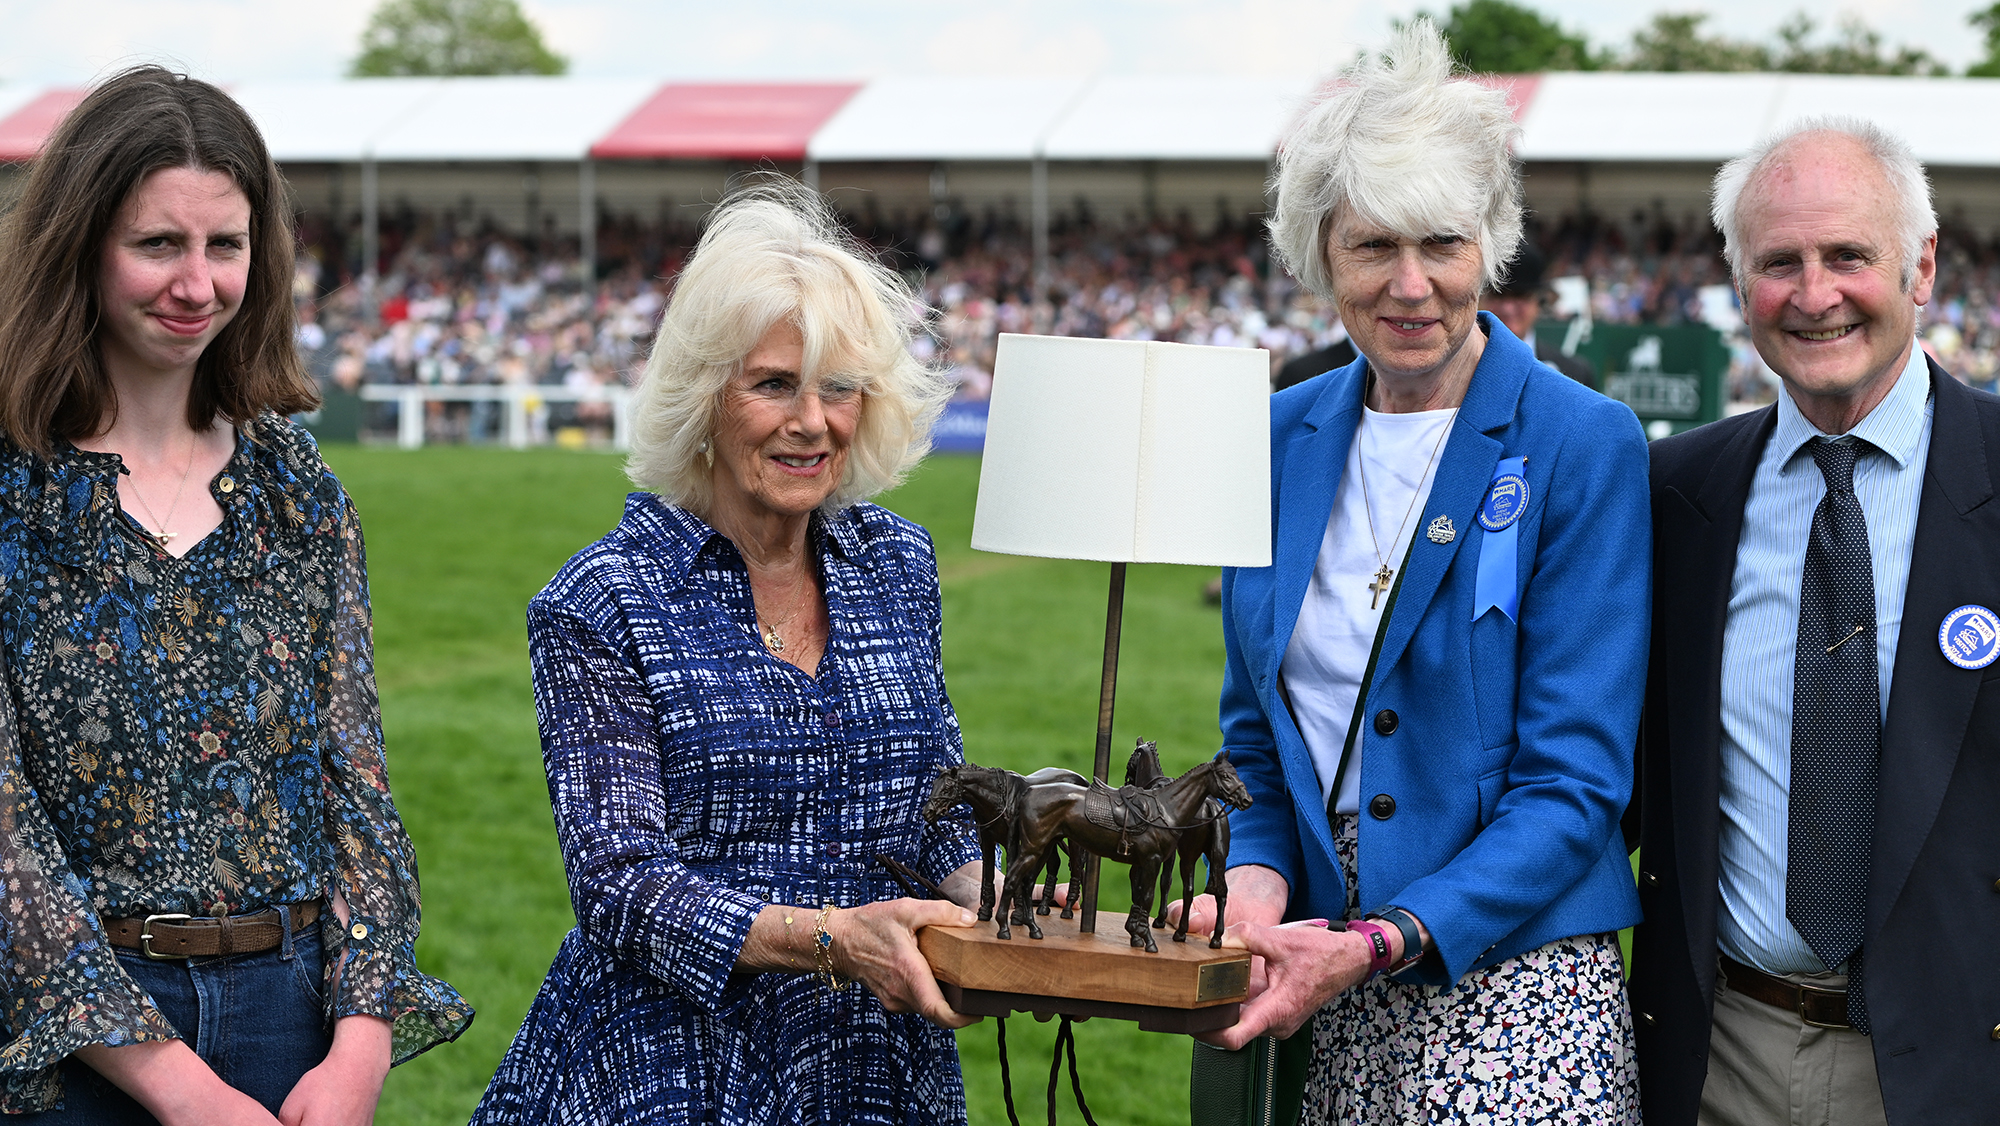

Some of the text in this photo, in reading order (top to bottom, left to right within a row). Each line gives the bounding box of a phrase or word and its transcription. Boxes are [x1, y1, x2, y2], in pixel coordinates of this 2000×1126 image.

[1499, 484, 1515, 493] MARS
[1978, 622, 1992, 639] MARS
[1950, 645, 1963, 659] 2024
[1953, 635, 1973, 656] VISITOR
